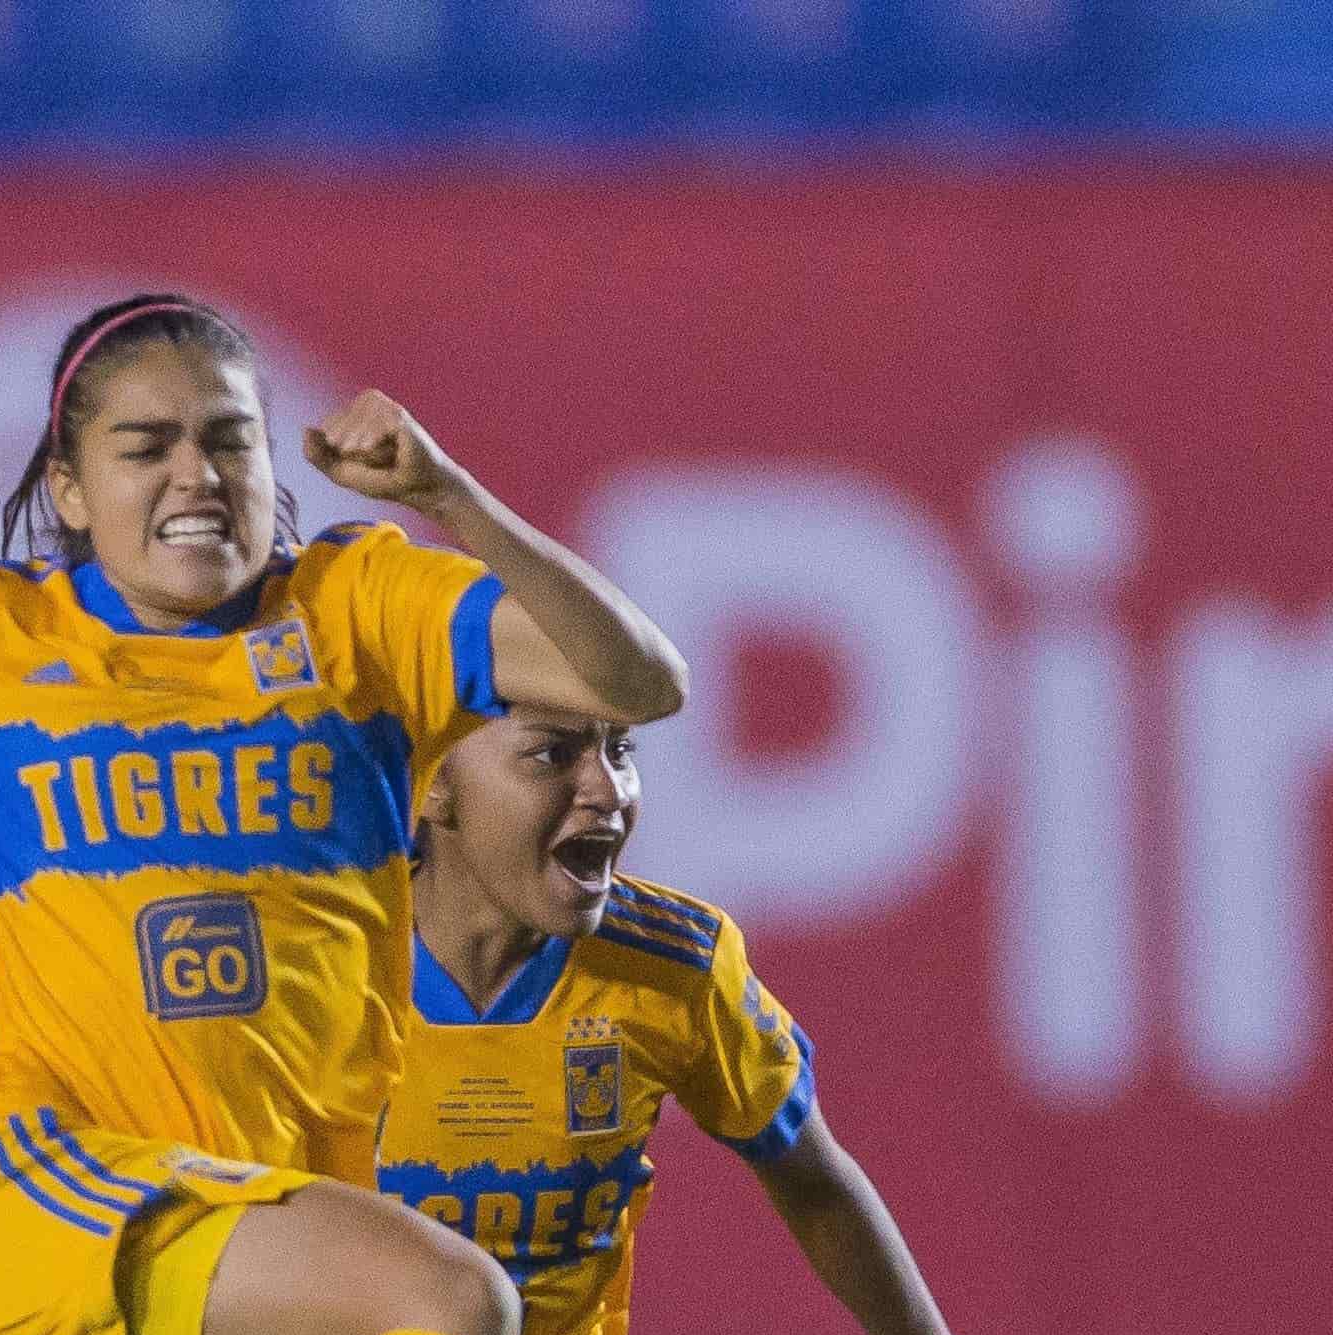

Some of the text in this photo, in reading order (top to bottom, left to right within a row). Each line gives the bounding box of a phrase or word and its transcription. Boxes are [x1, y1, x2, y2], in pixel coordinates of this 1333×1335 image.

[18, 742, 334, 854] TIGRES
[162, 945, 248, 998] GO
[381, 1180, 620, 1257] GRES
